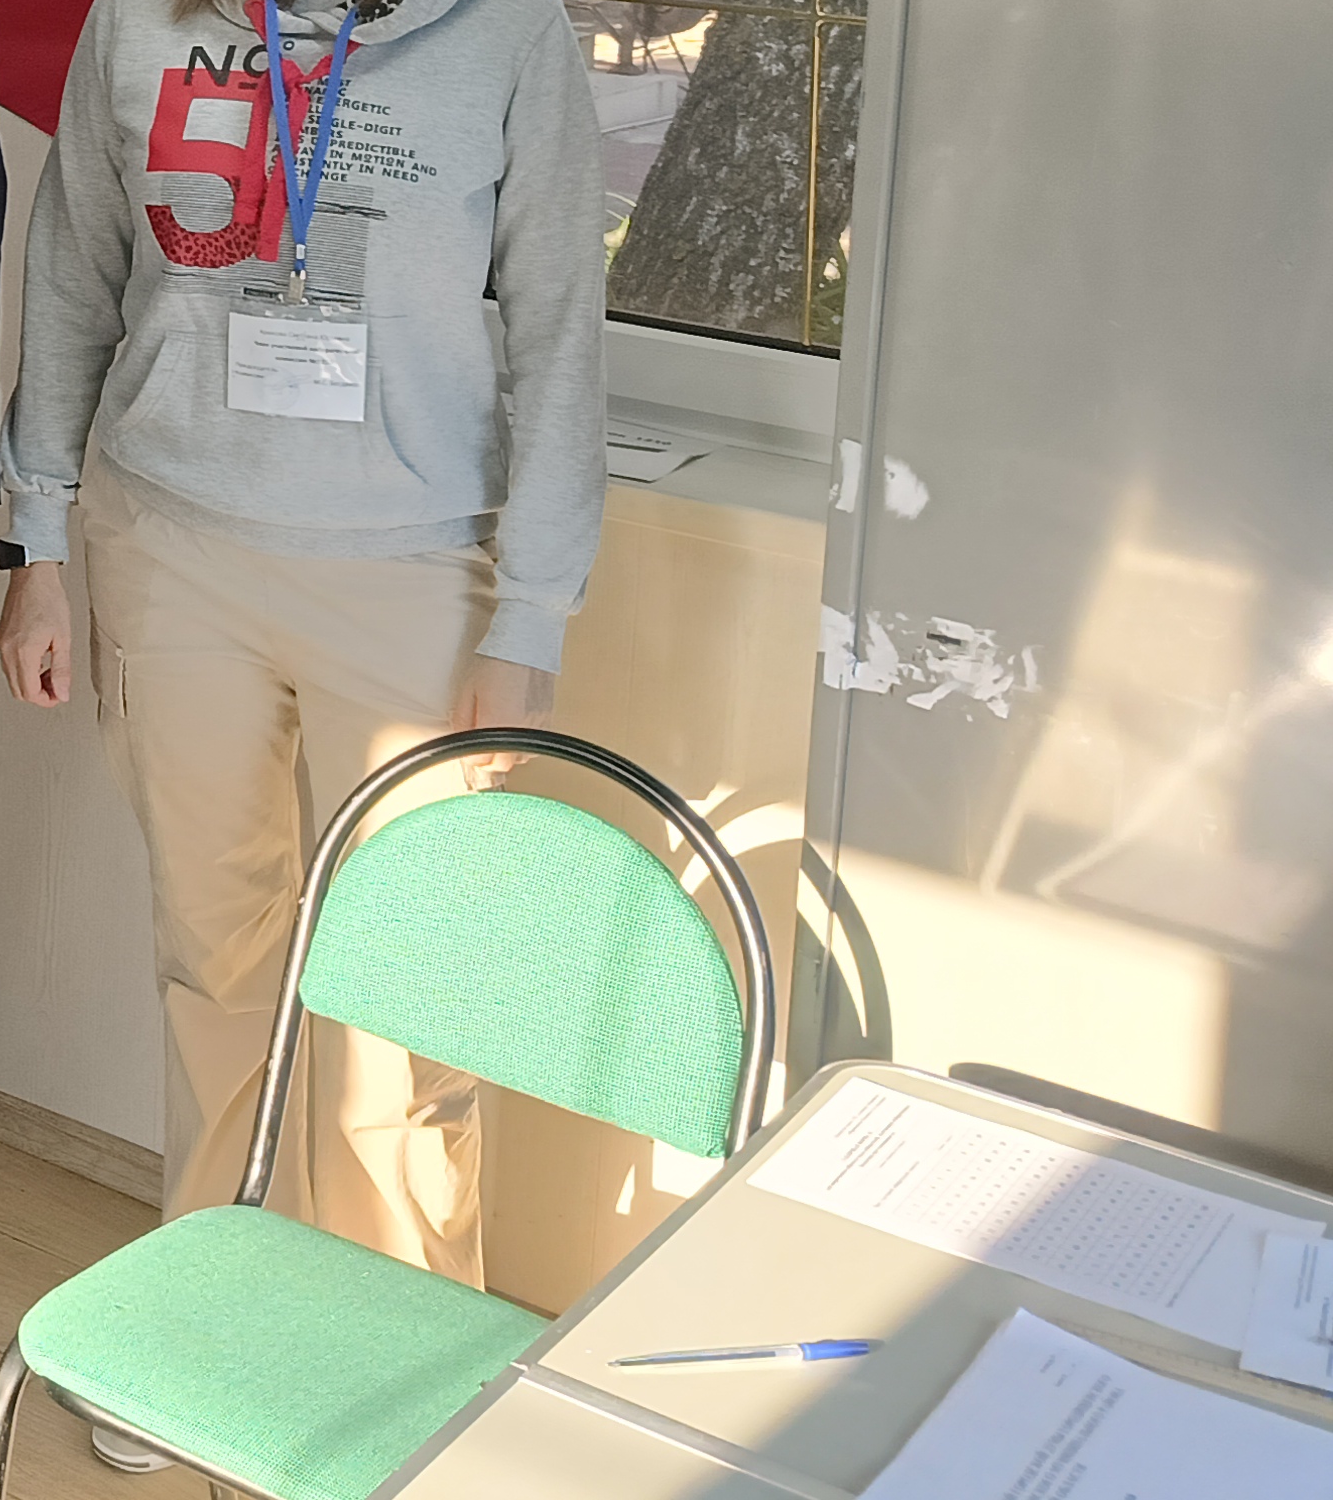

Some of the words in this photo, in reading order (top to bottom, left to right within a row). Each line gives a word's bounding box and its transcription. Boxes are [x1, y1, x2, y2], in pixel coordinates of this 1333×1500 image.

[317, 96, 392, 116] EERGETIC
[308, 114, 403, 136] SIGLE-DIGIT
[351, 152, 405, 168] MOTION
[411, 162, 438, 176] AND
[359, 163, 375, 175] IN
[382, 168, 419, 183] NEED
